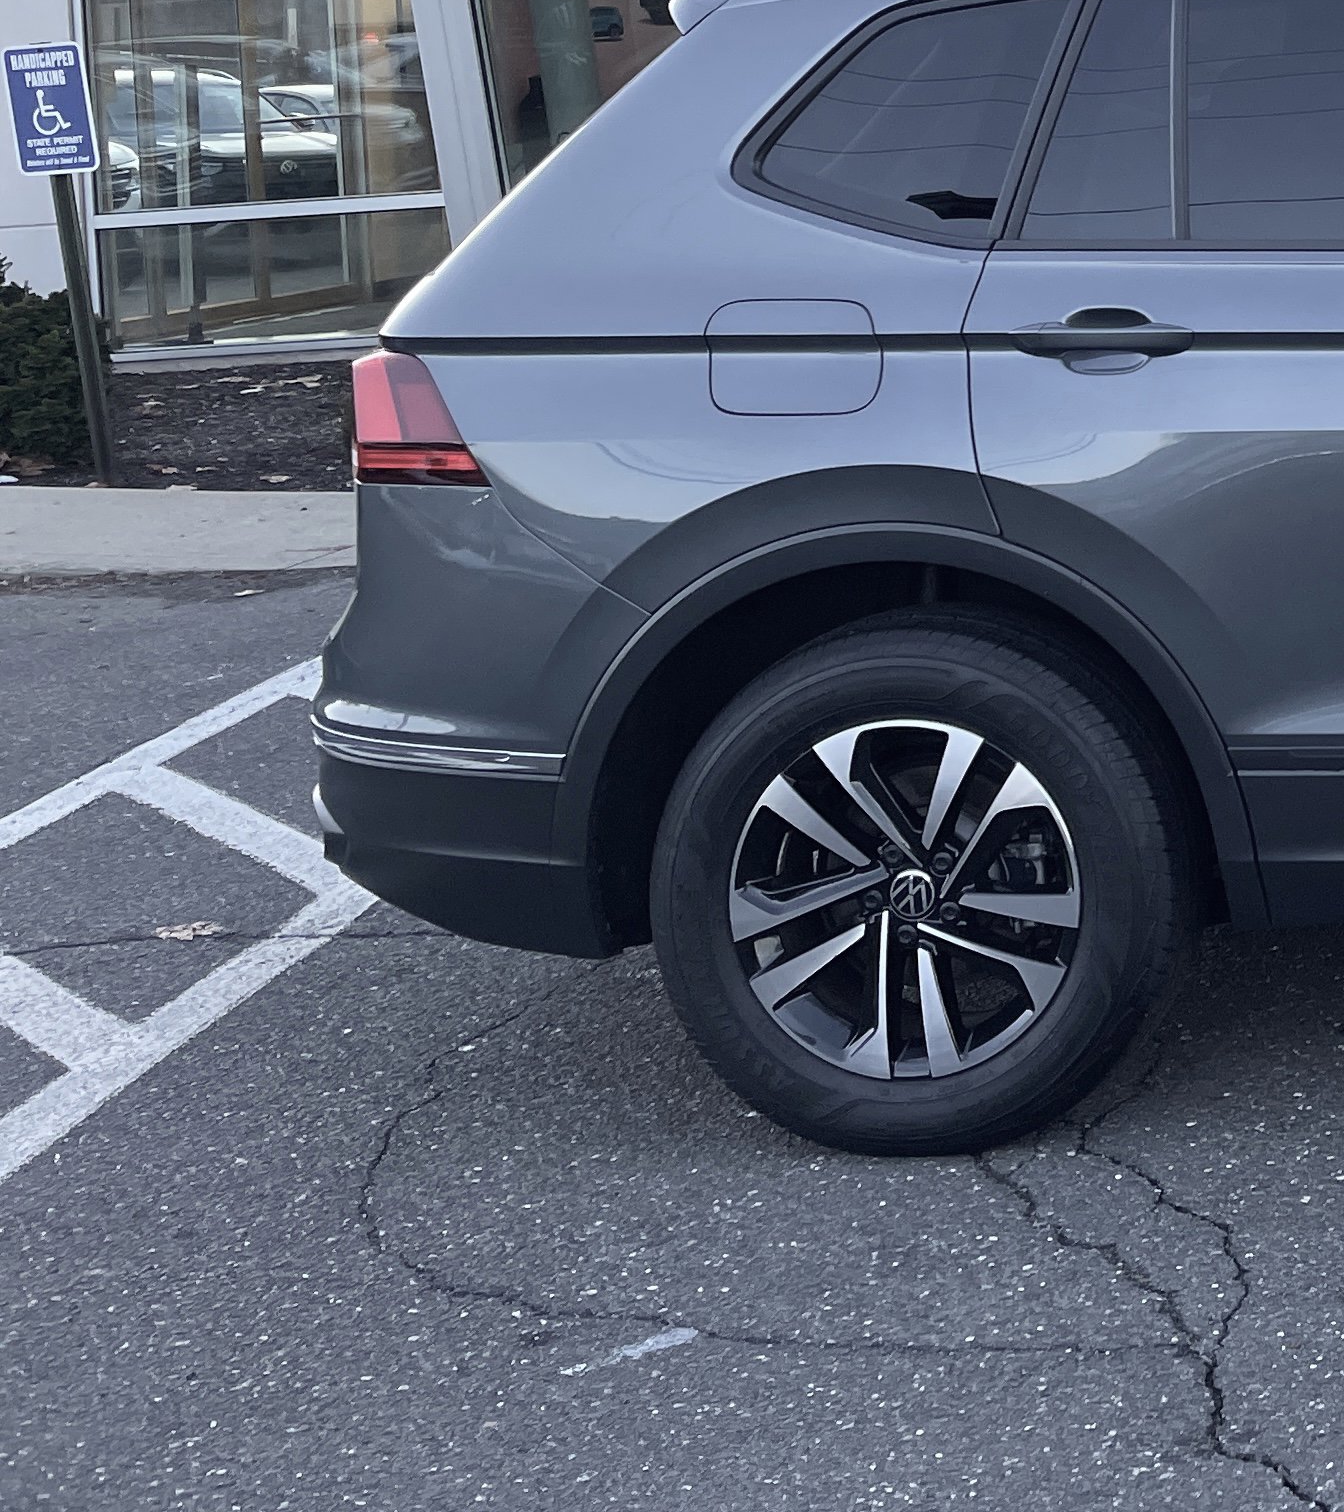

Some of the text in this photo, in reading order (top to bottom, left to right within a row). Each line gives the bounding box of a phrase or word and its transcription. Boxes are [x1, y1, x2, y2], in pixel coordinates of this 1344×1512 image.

[10, 50, 75, 71] HANDICAPPED
[24, 69, 67, 88] PARKING
[26, 135, 84, 148] STATE PERMIT
[35, 145, 78, 156] REQUIRED
